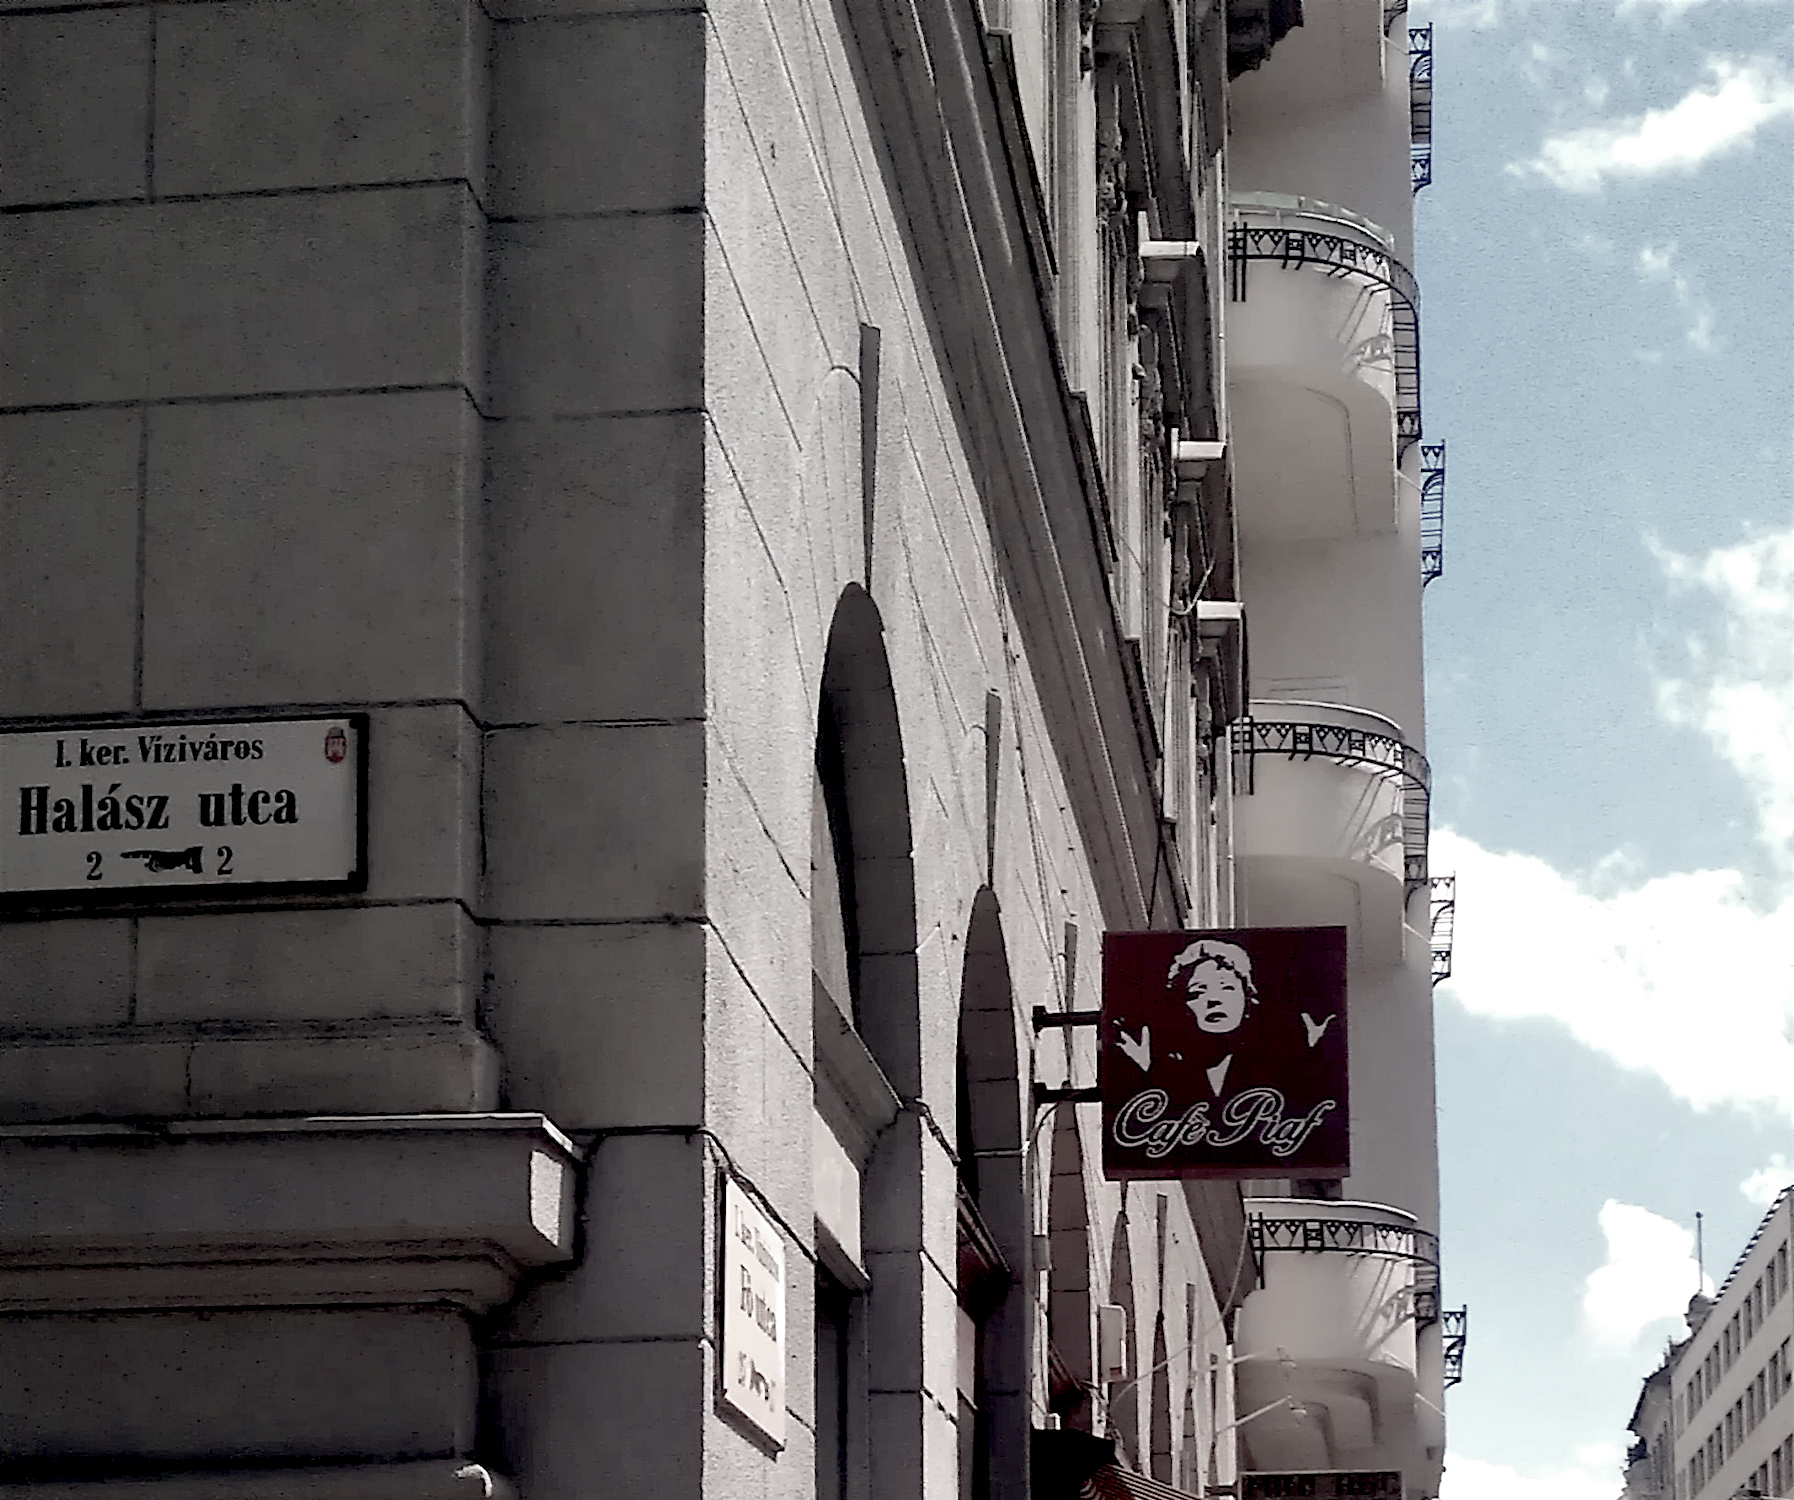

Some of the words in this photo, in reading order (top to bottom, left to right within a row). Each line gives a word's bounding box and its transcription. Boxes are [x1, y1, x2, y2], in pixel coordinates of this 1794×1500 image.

[55, 740, 72, 767] I.
[79, 738, 129, 766] ker.
[137, 734, 263, 763] Víziváros
[18, 783, 170, 836] Halász
[198, 783, 298, 828] utca
[86, 851, 103, 881] 2
[216, 846, 233, 875] 2
[1206, 1087, 1336, 1157] Piaf
